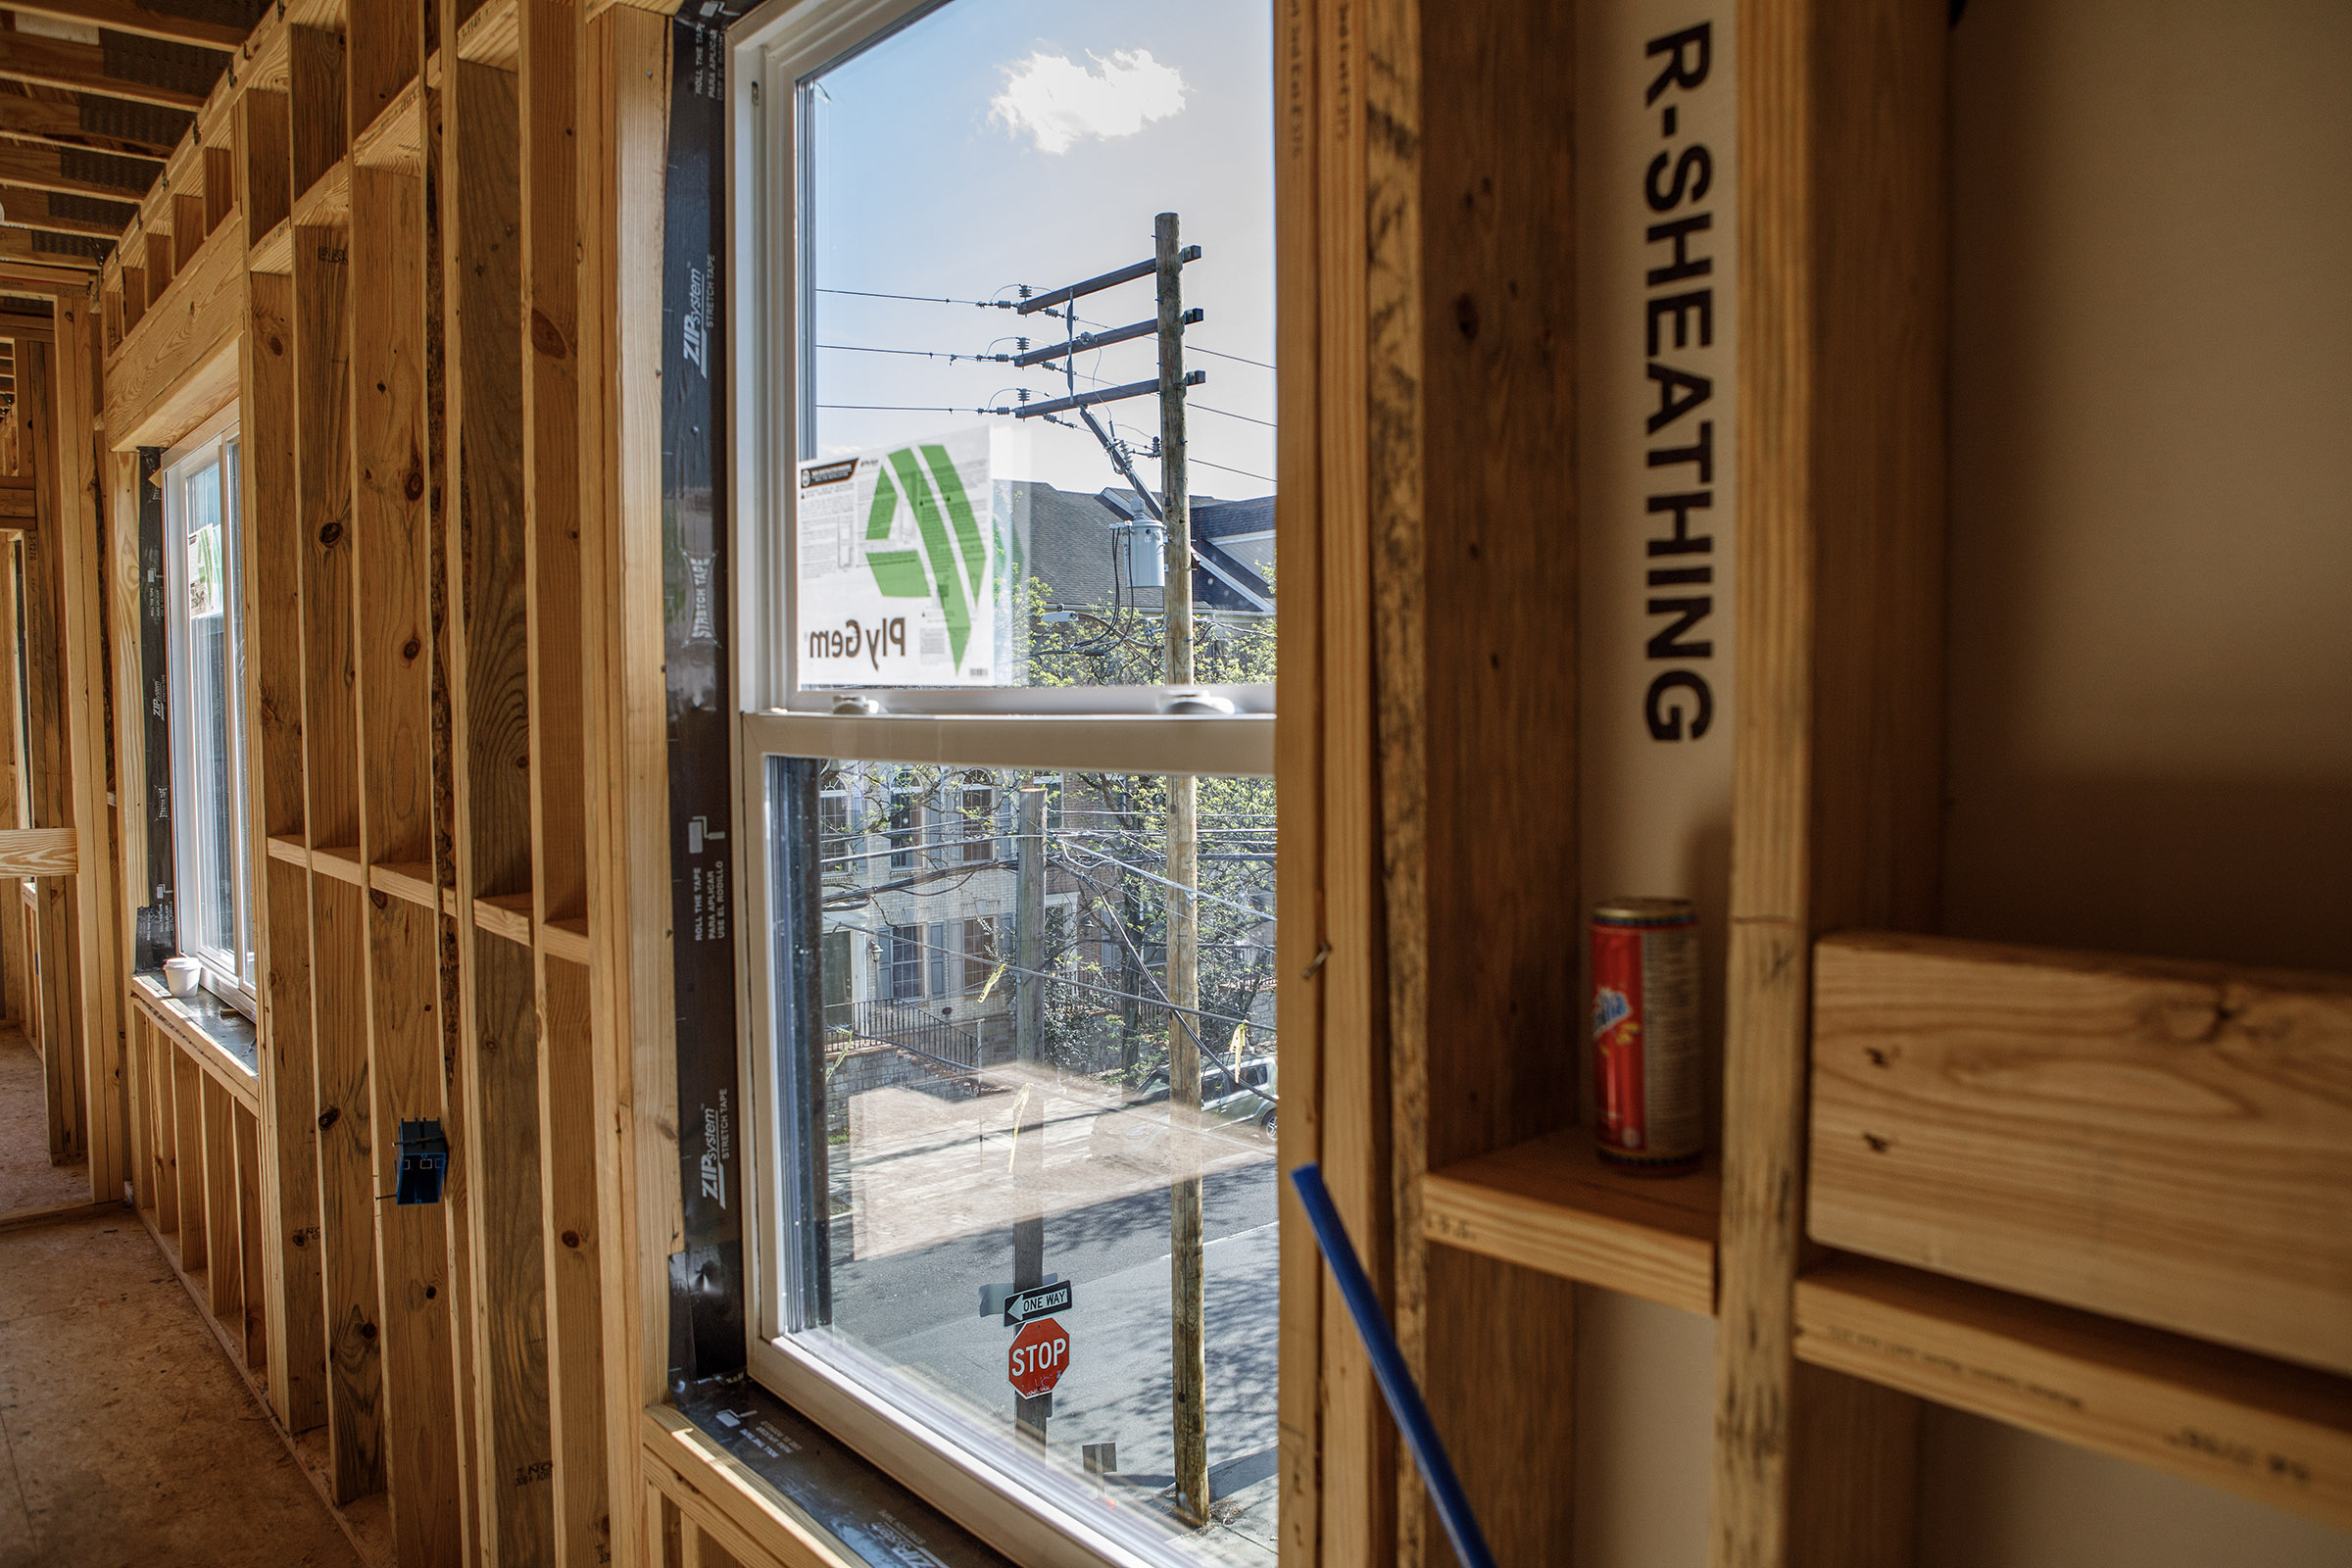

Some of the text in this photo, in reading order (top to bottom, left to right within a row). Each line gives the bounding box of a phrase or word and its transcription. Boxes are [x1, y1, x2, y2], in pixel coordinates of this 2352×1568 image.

[706, 254, 715, 328] STRETCH TAPE
[1644, 20, 1715, 743] R-SHEATHING
[689, 558, 713, 638] STRETCH TAPE
[693, 867, 704, 942] ROLL THE TAPE
[707, 870, 716, 940] PARA APLICAR
[715, 860, 724, 903] RODILLO
[716, 905, 725, 917] EL
[718, 1088, 730, 1159] STRETCH TAPE
[1023, 1290, 1066, 1312] ONE WAY
[1011, 1338, 1066, 1377] STOP
